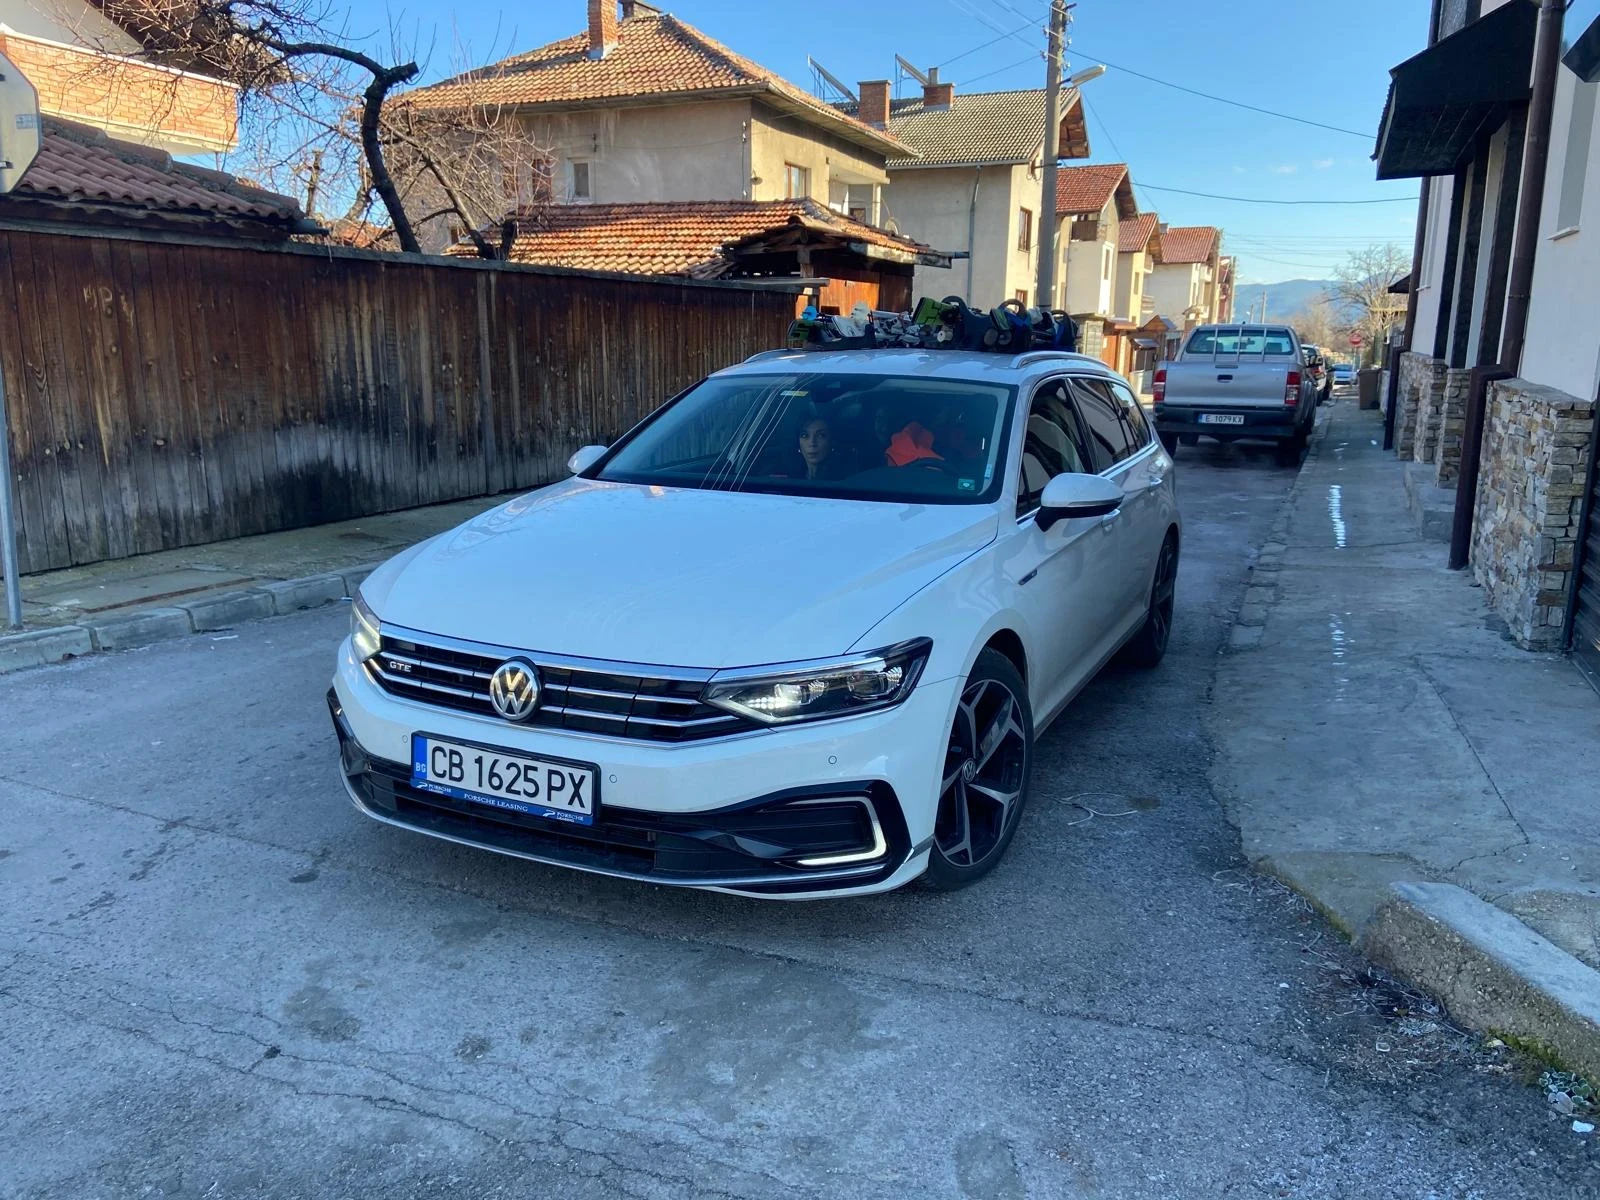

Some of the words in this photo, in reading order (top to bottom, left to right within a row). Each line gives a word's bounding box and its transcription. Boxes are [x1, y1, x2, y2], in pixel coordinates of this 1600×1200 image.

[389, 660, 412, 673] GTE
[415, 763, 427, 773] BG
[431, 746, 464, 783] CB
[474, 755, 540, 798] 1625
[464, 793, 496, 805] PORSCHE
[497, 800, 529, 812] LEASING
